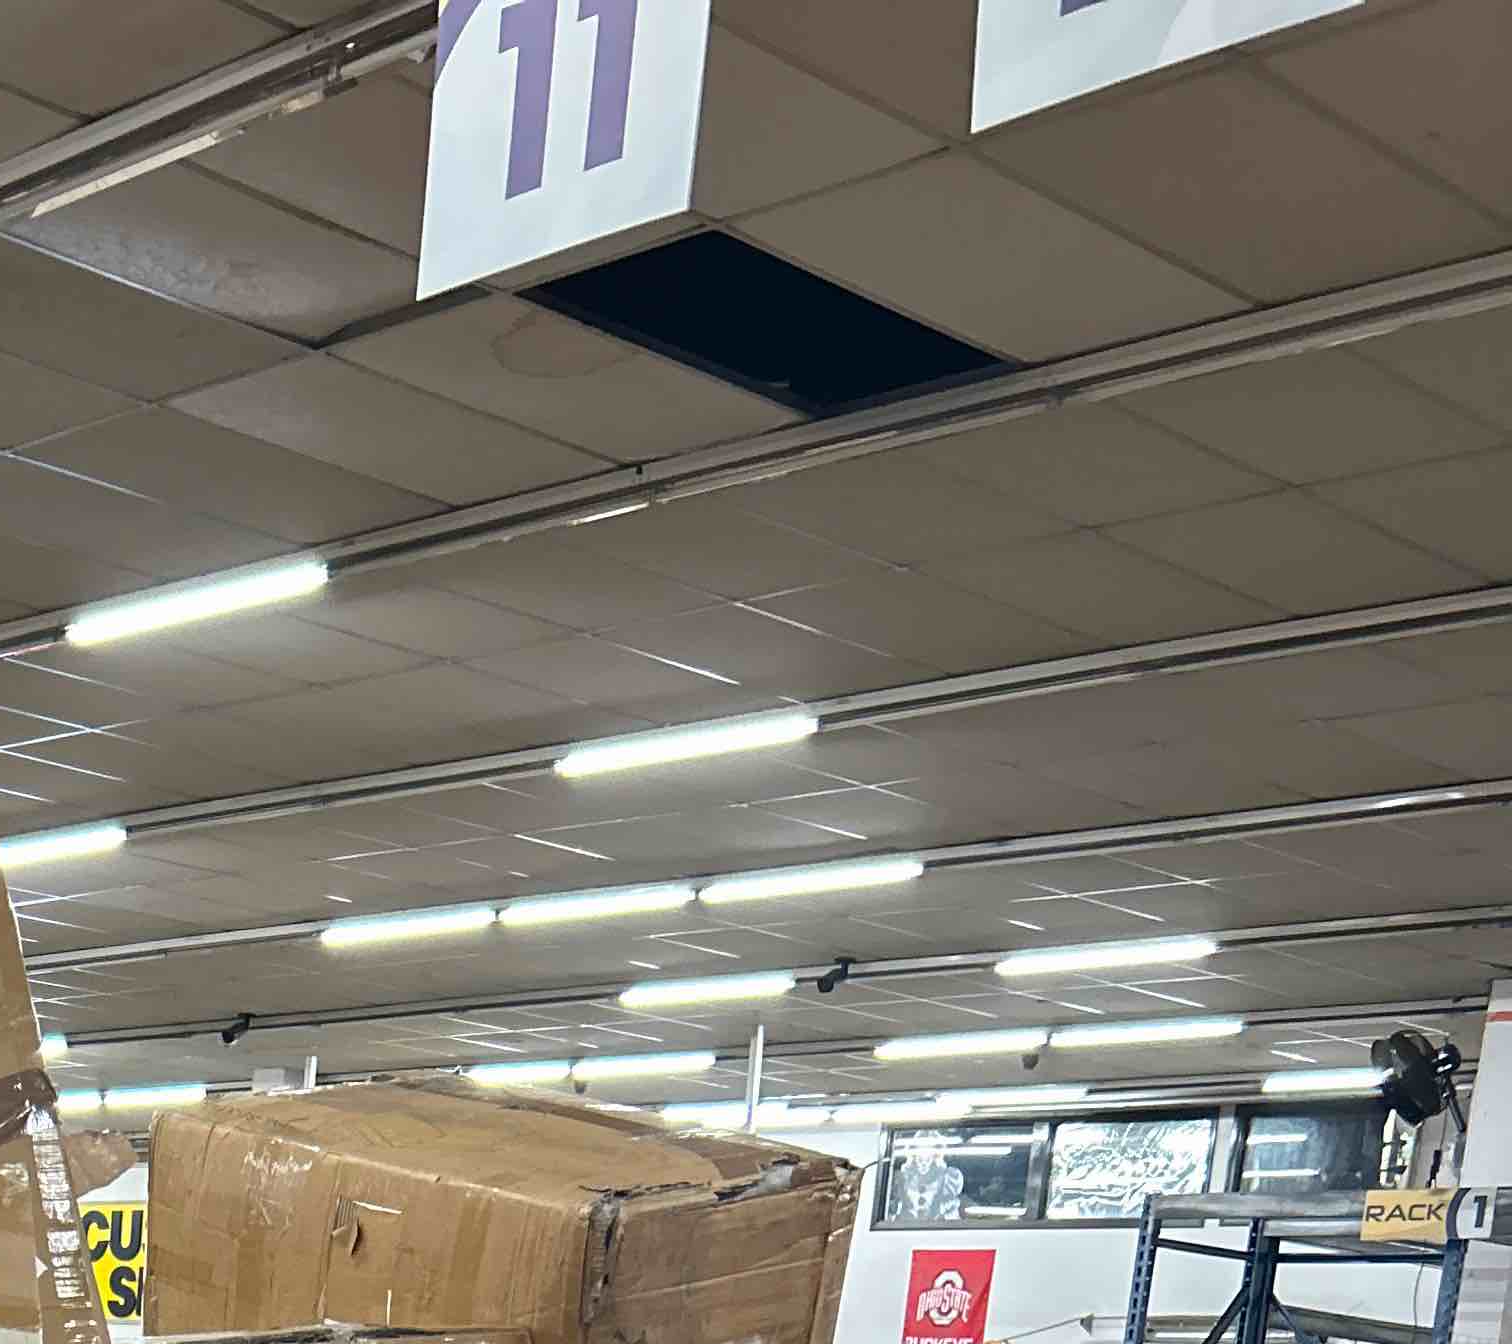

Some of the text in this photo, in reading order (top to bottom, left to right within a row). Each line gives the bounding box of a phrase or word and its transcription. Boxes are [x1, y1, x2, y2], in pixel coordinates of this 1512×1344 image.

[498, 0, 638, 200] 11
[82, 1210, 145, 1261] CU
[1364, 1195, 1488, 1229] RACK 1
